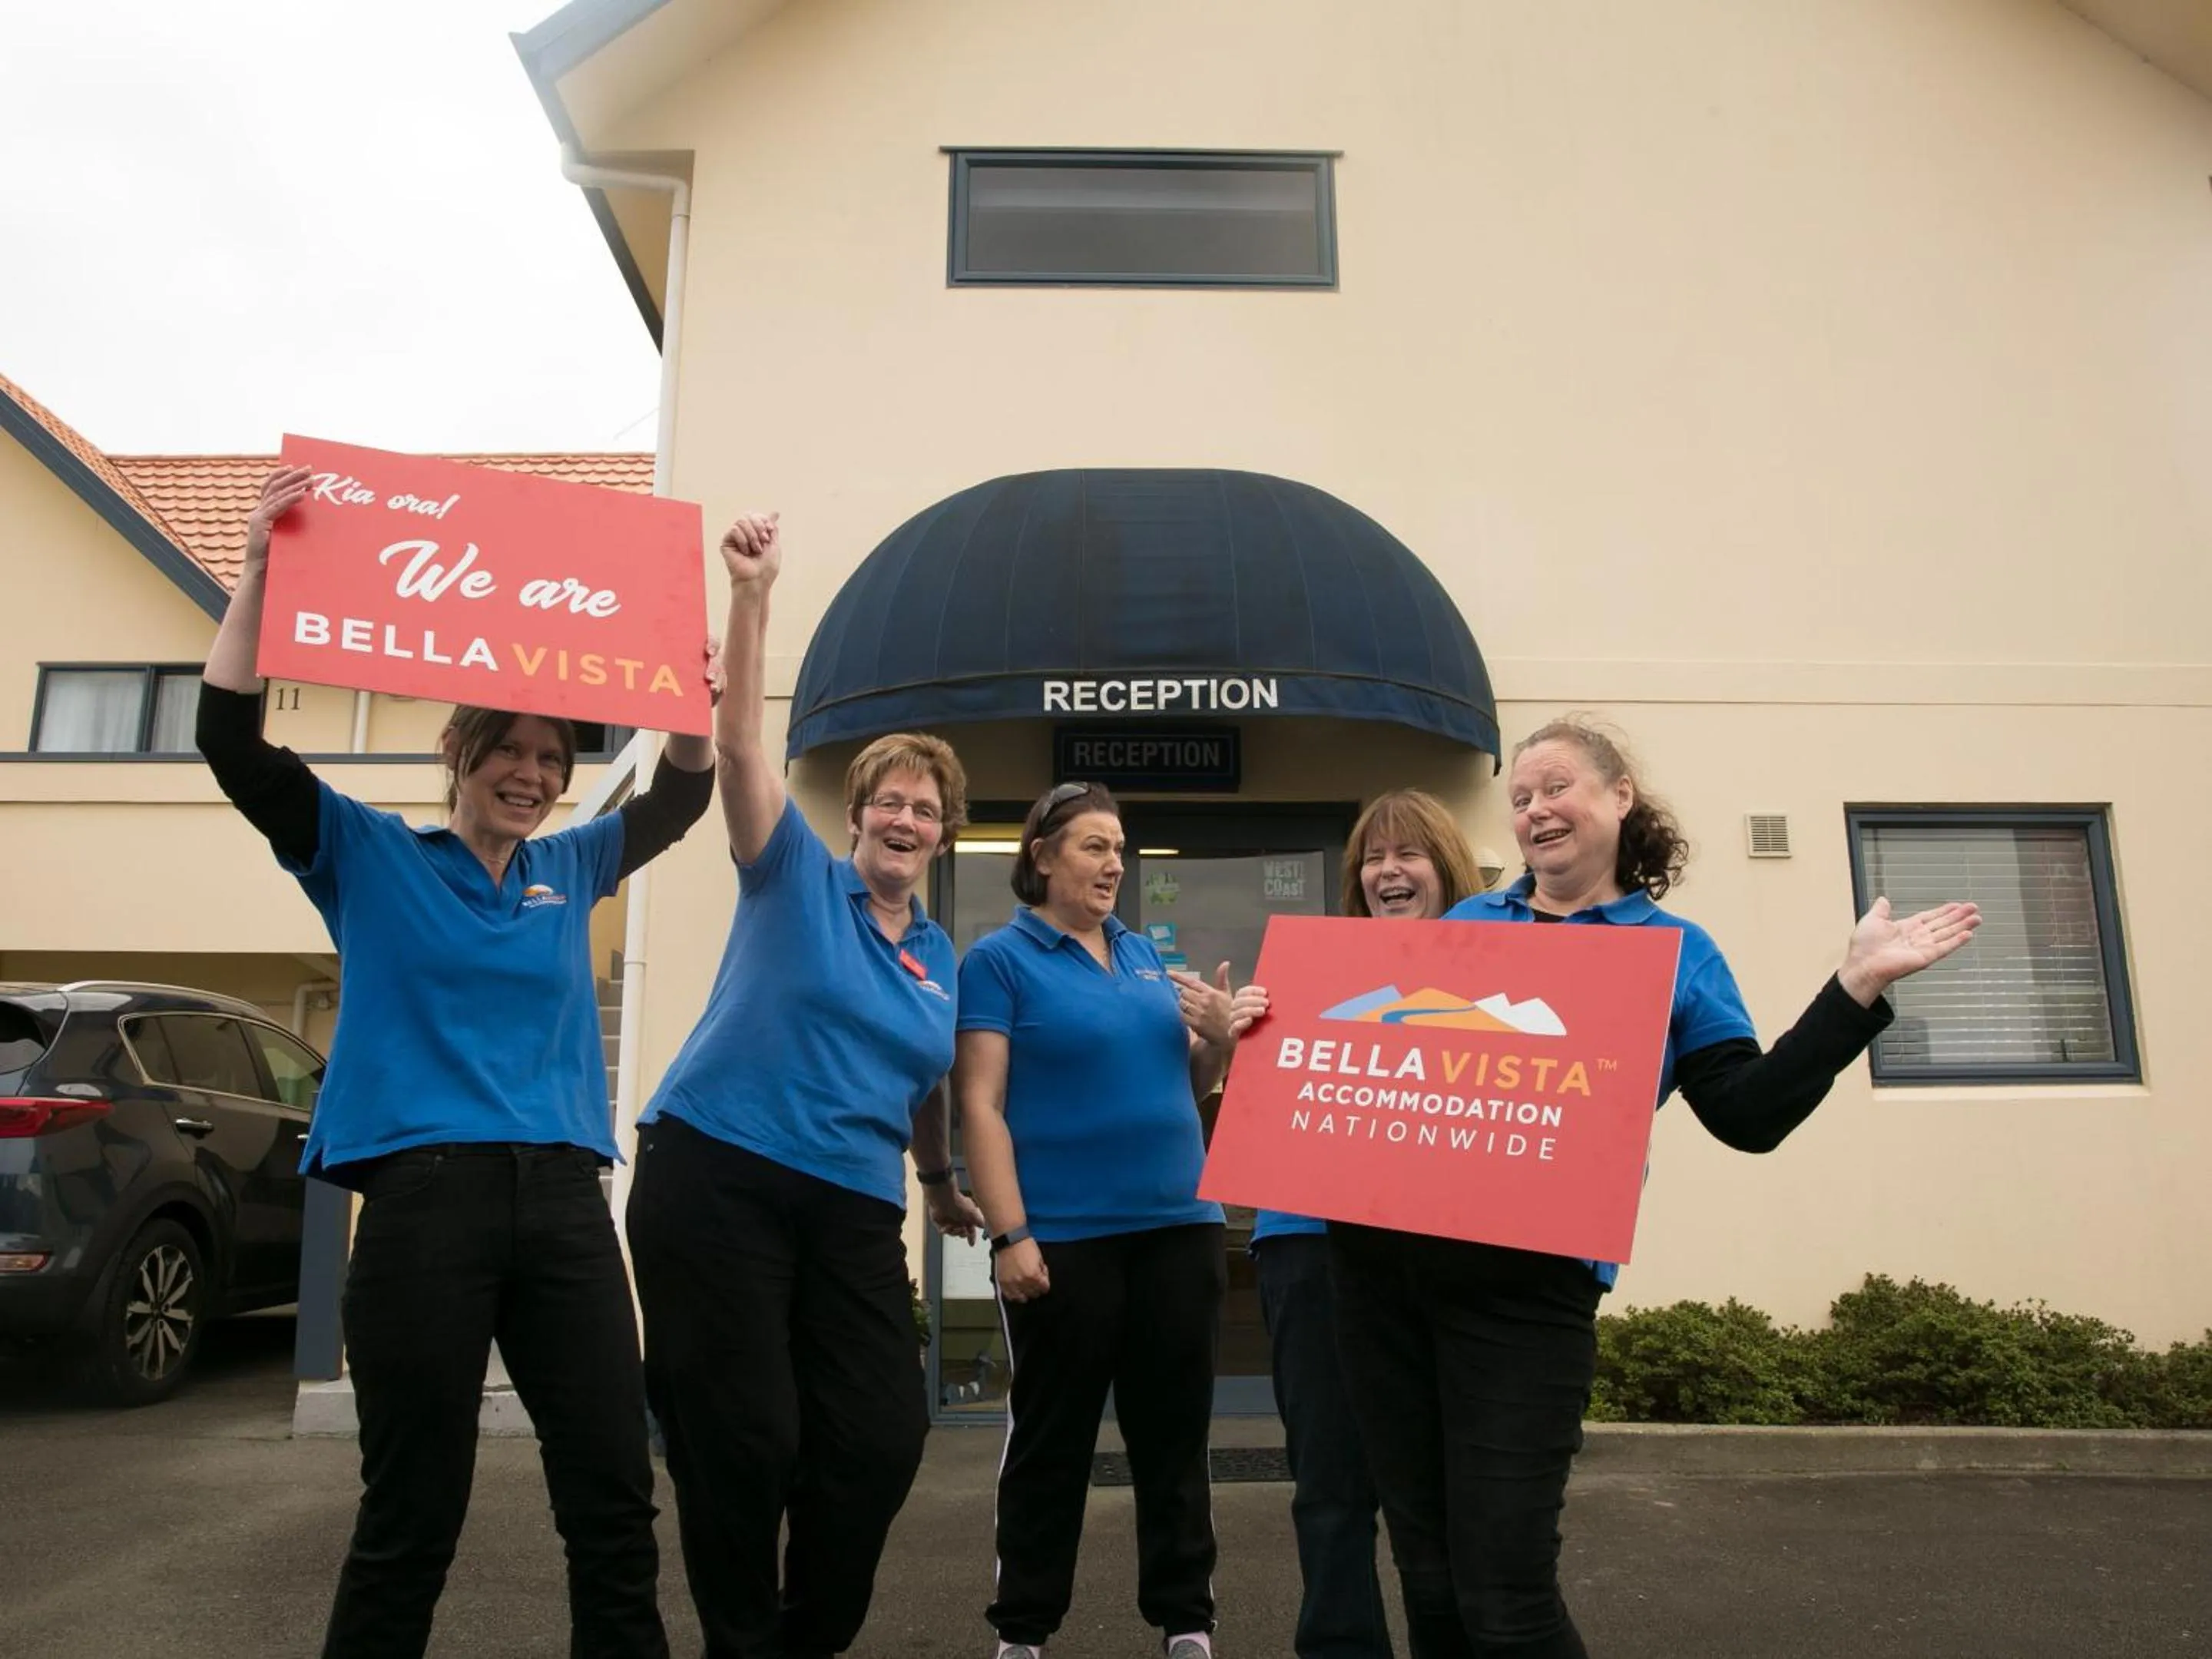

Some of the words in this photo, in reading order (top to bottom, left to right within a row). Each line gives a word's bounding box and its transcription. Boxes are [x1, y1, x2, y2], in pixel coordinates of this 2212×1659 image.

[310, 472, 376, 505] Kia
[387, 494, 460, 519] ora!
[379, 539, 498, 602] We
[519, 577, 621, 618] are
[294, 611, 498, 671] BELLA
[512, 643, 684, 697] VISTA
[276, 687, 300, 710] 11
[1043, 678, 1279, 711] RECEPTION
[1075, 741, 1220, 767] RECEPTION
[1264, 879, 1306, 897] COAST
[1277, 1038, 1426, 1081] BELLA
[1297, 1081, 1562, 1128] ACCOMMODATION
[1291, 1110, 1557, 1161] NATIONWIDE
